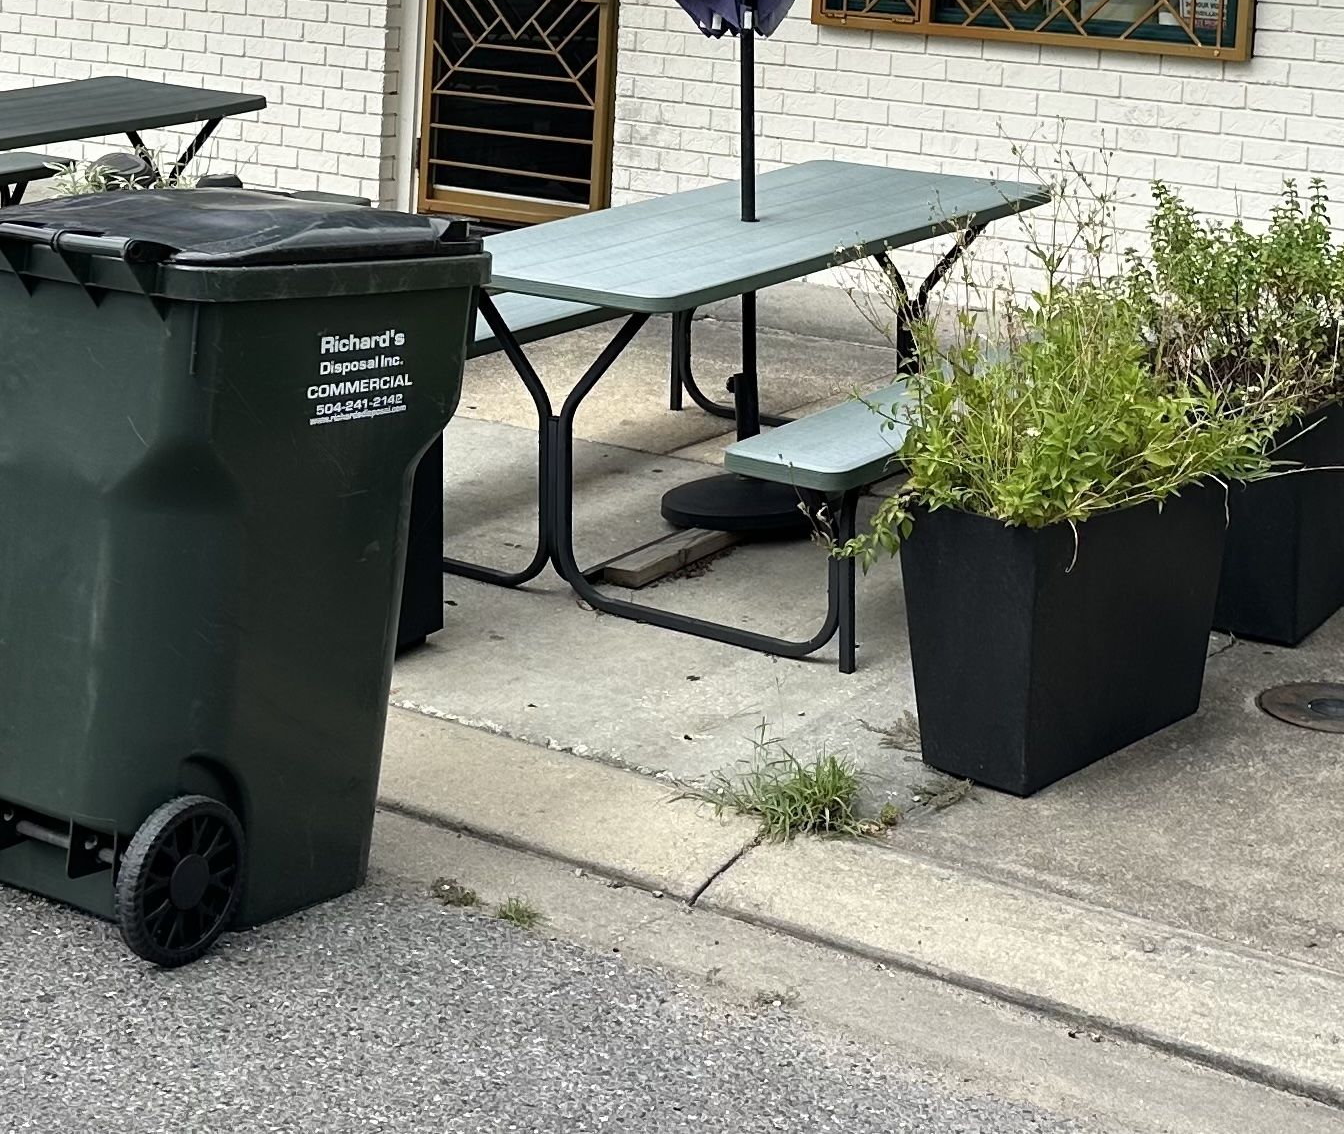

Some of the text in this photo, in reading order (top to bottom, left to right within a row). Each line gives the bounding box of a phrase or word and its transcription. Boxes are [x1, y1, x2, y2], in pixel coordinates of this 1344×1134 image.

[320, 329, 405, 355] Richard's
[319, 354, 404, 376] Disposal Inc.
[307, 373, 413, 399] COMMERCIAL
[315, 393, 403, 416] 504-241-2142
